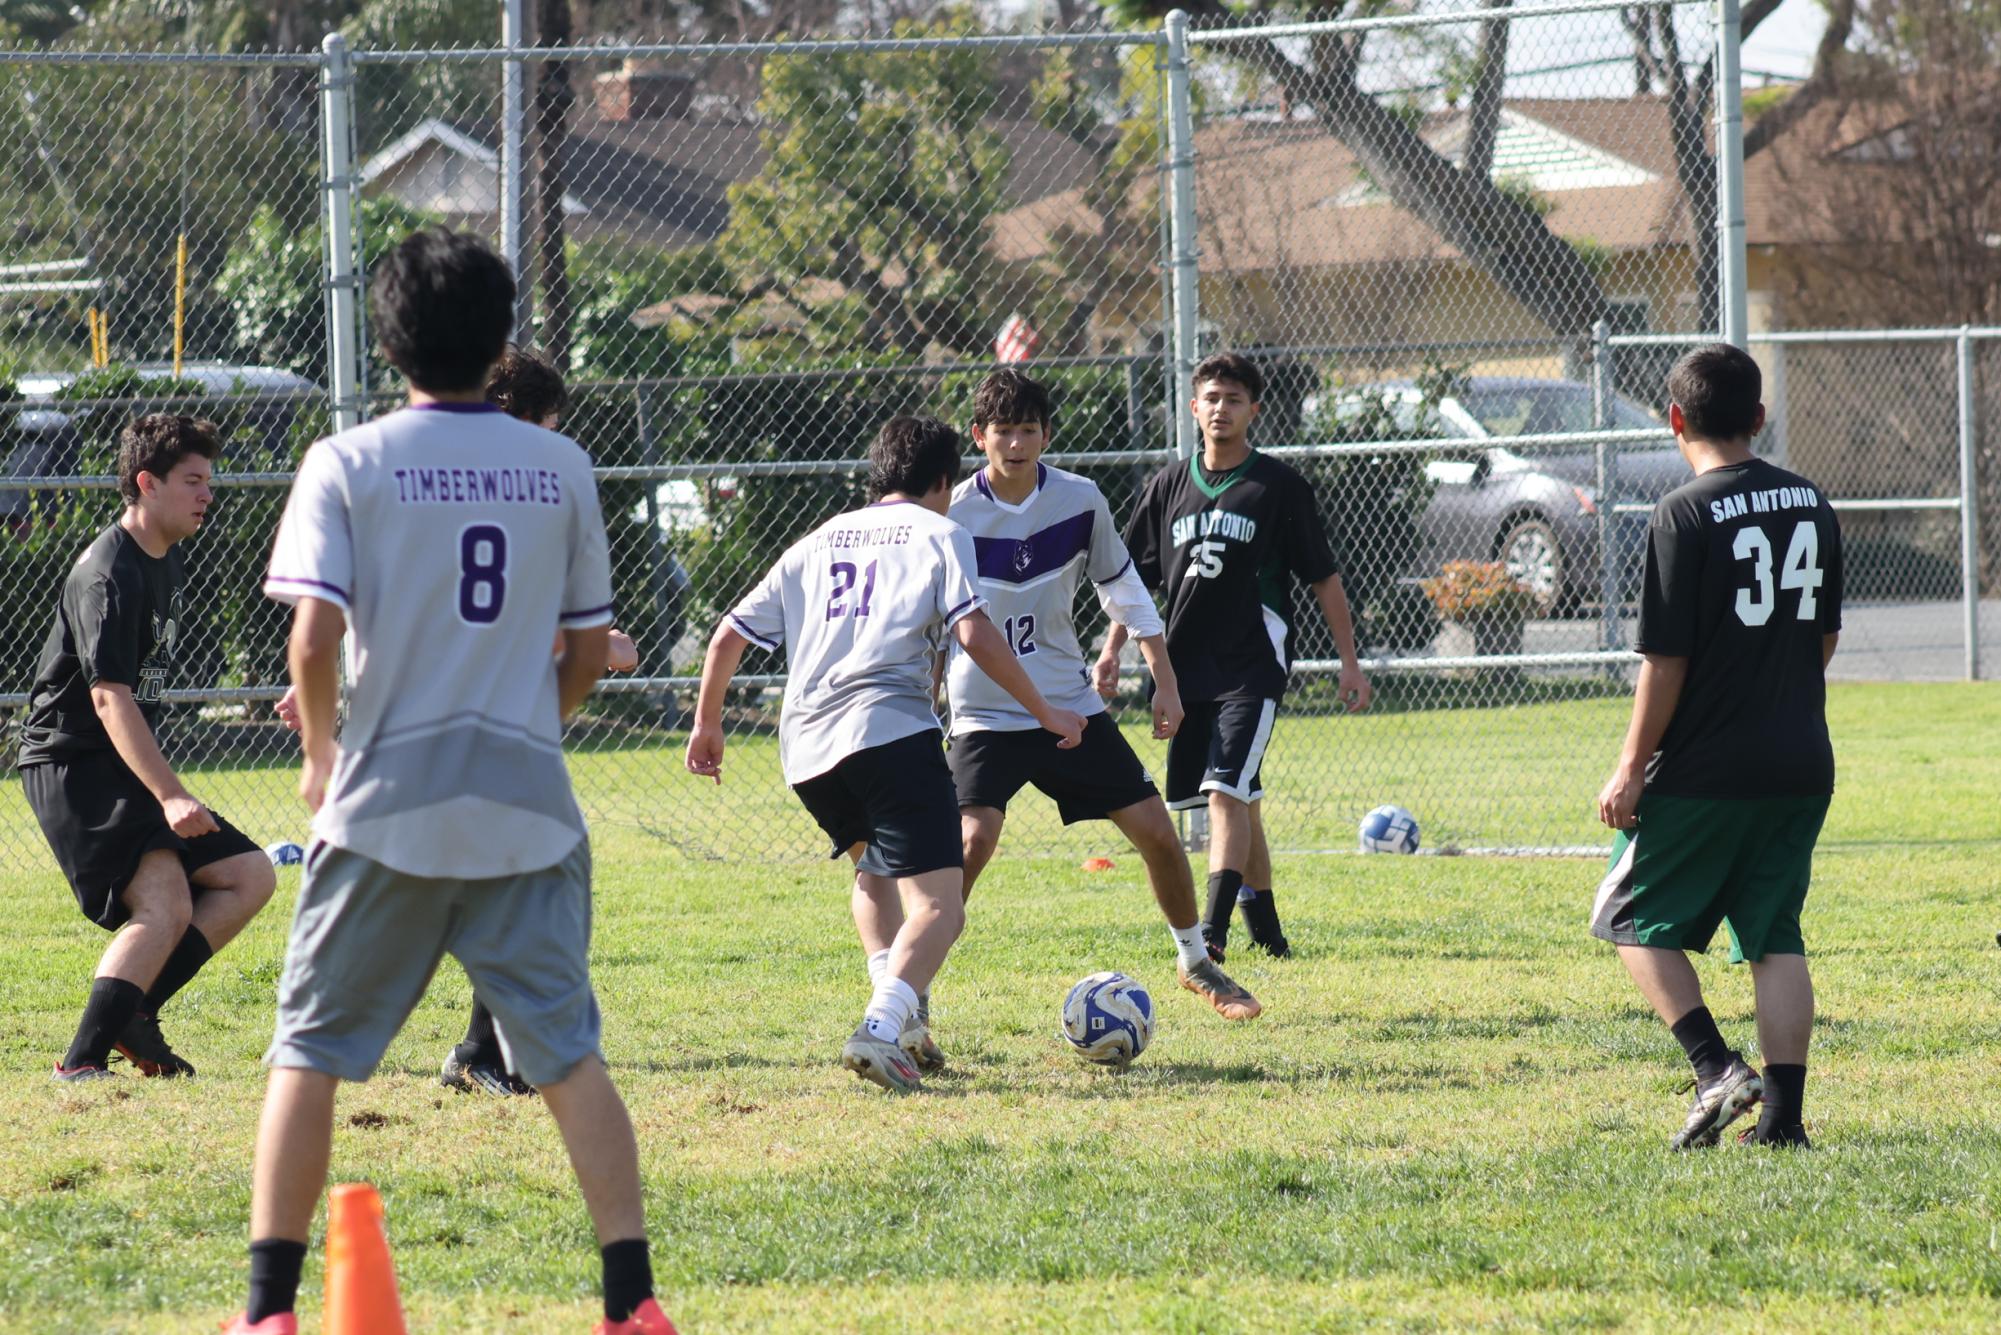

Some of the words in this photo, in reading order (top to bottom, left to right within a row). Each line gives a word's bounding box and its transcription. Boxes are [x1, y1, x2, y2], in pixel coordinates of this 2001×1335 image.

[395, 469, 560, 505] TIMBERWOLVES
[1711, 493, 1748, 523] SAN
[1751, 487, 1818, 513] ANTONIO
[1171, 513, 1197, 549] SAN
[459, 524, 507, 624] 8
[826, 559, 878, 622] 21
[1732, 520, 1824, 627] 34
[1004, 614, 1037, 657] 12
